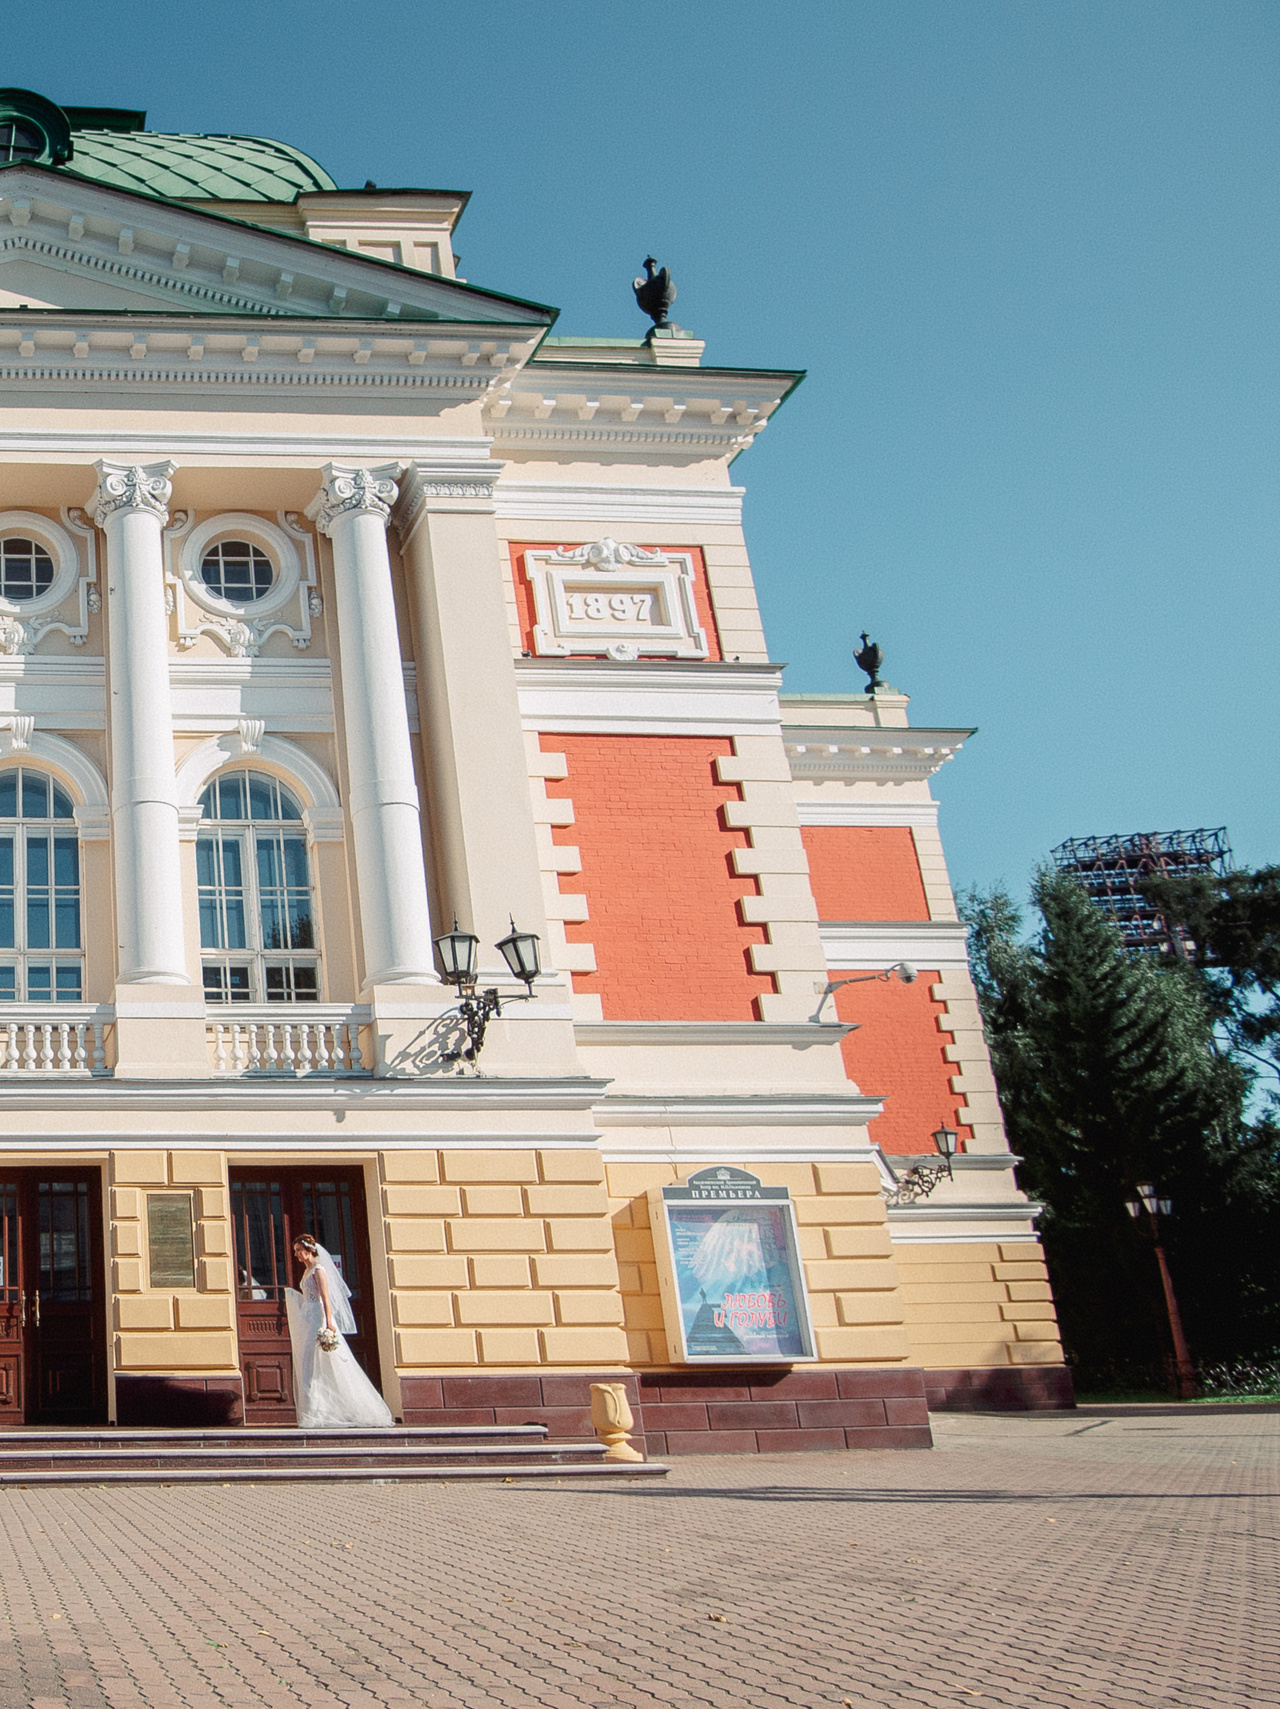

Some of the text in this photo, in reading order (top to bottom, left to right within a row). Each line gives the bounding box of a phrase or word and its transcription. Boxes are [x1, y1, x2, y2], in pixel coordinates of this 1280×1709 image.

[567, 593, 652, 620] 1897
[691, 1190, 761, 1198] ПРЕМЬЕРА
[721, 1292, 787, 1309] ЛЮБОВЬ
[714, 1310, 788, 1329] И ГОЛУБИ
